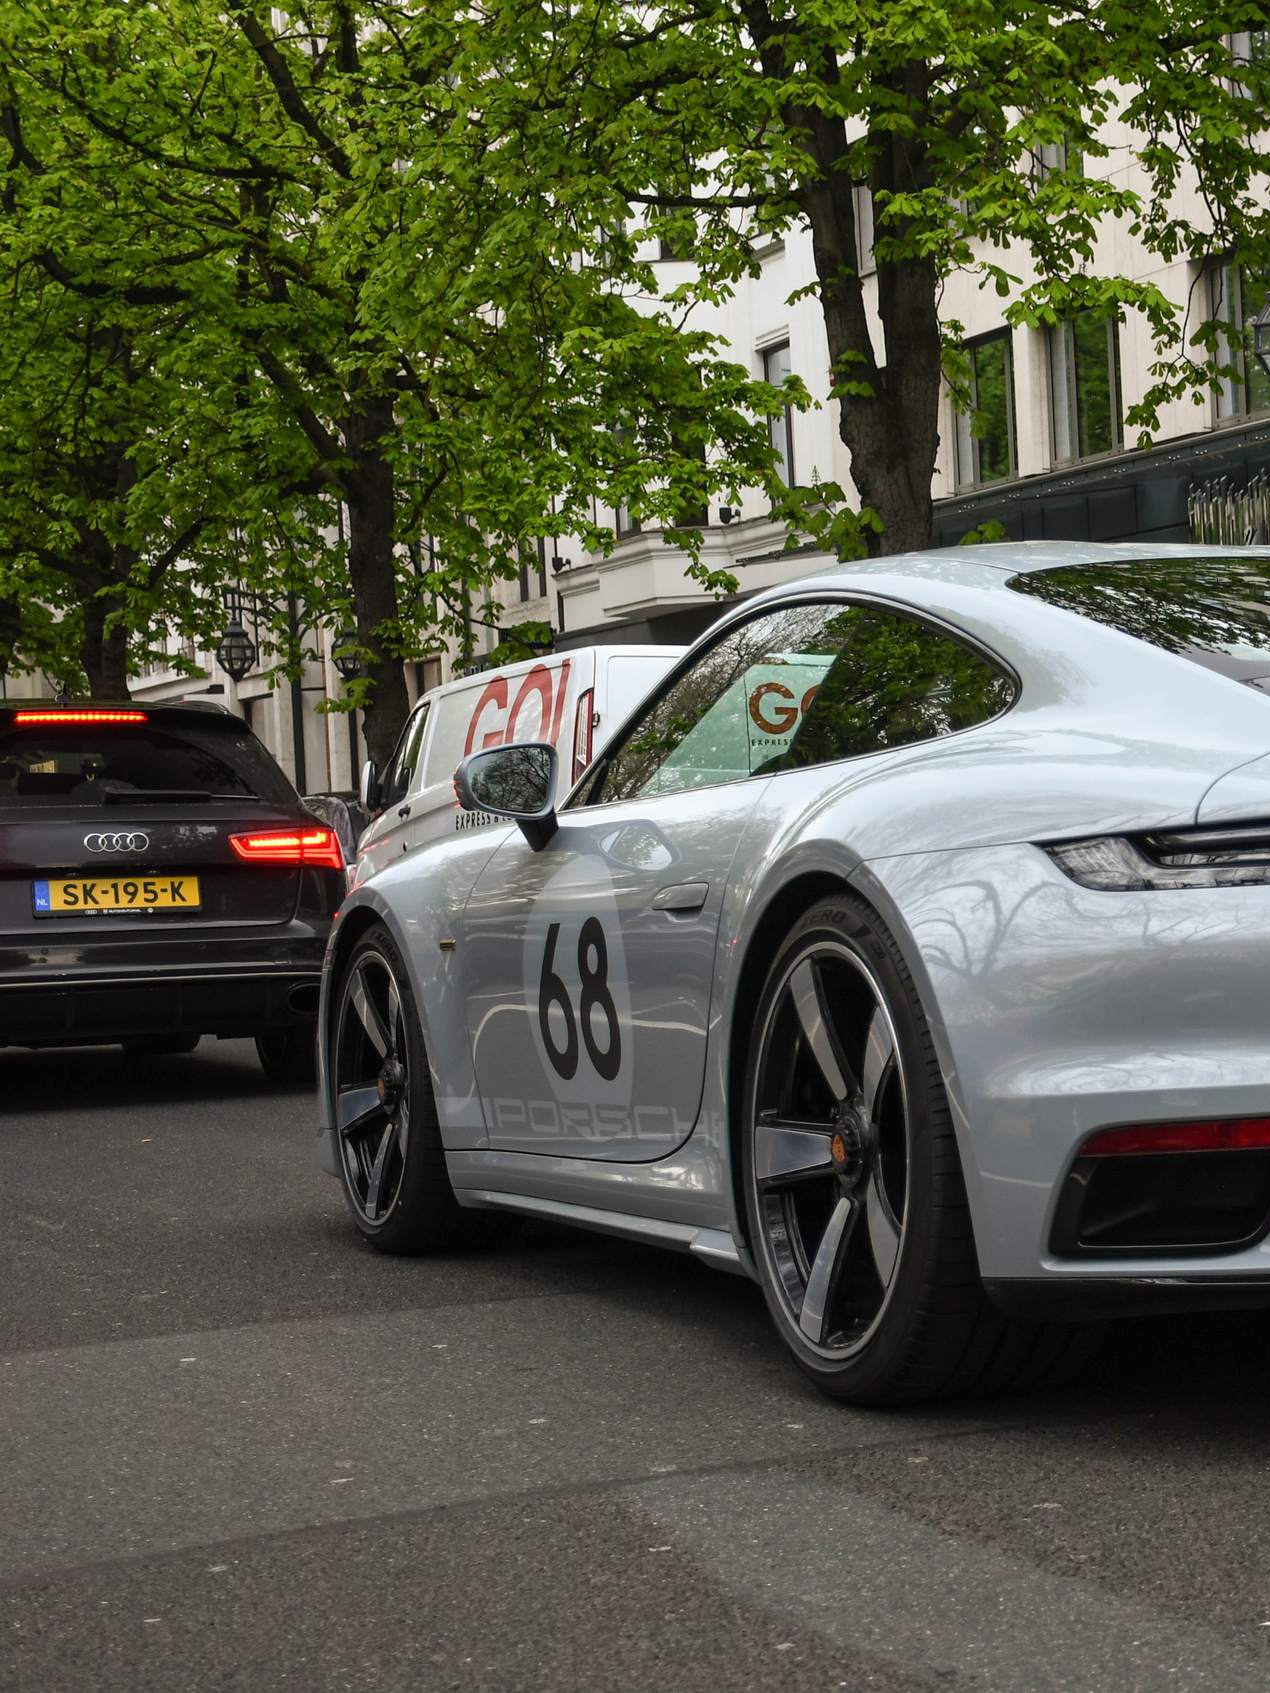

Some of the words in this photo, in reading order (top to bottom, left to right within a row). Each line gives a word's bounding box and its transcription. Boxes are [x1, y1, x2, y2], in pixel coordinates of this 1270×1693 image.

[63, 881, 187, 906] SK-195-K
[539, 916, 622, 1081] 68
[493, 1099, 720, 1150] PORSCHE
